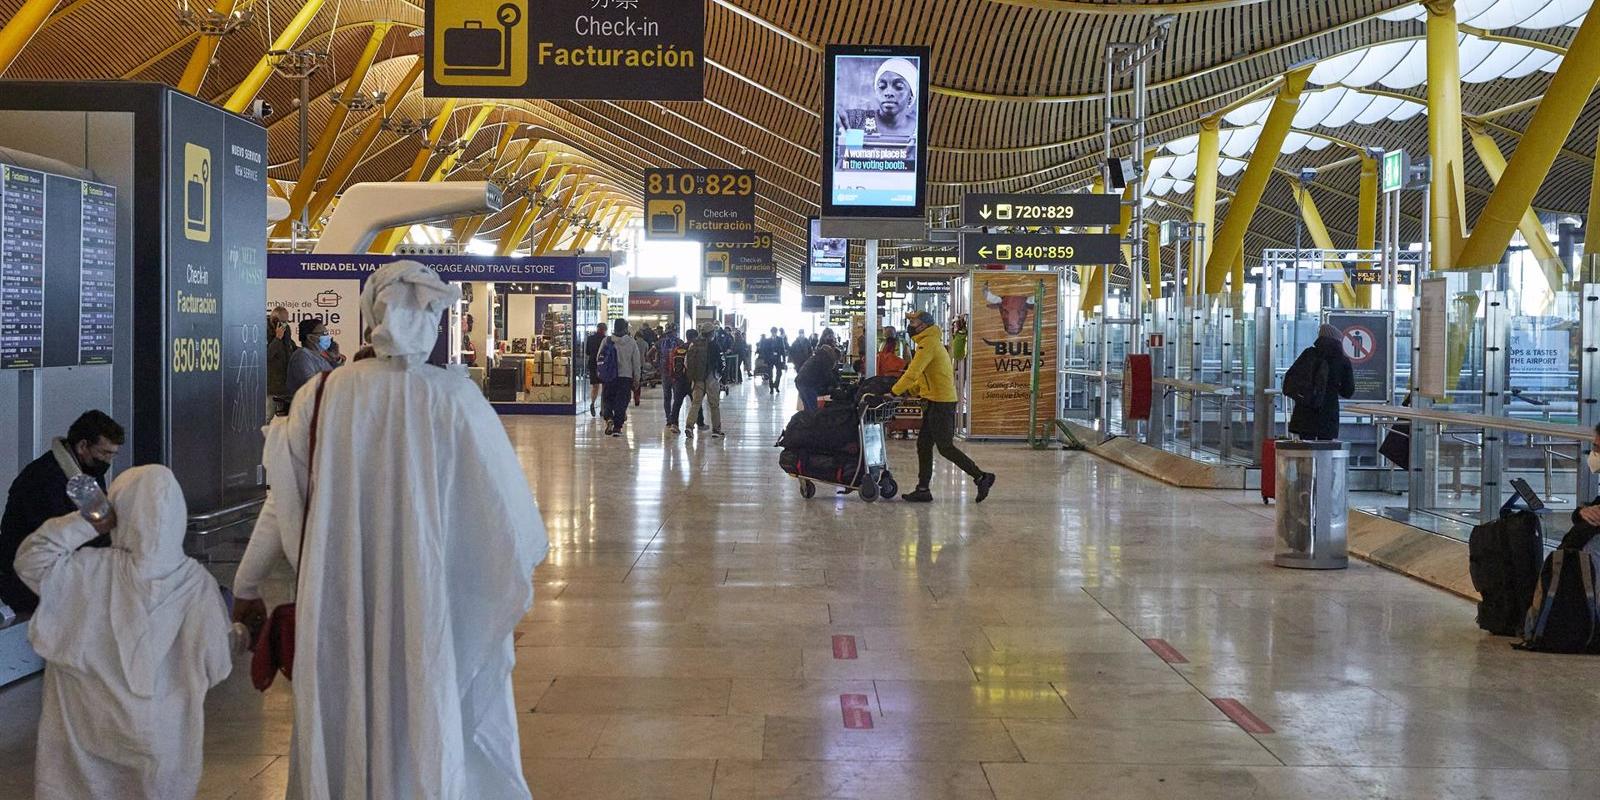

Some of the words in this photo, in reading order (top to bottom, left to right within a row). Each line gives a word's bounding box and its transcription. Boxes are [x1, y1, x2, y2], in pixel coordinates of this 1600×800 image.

[575, 15, 659, 36] Check-in
[538, 42, 694, 67] Facturación
[844, 149, 849, 158] A
[850, 149, 880, 158] woman's
[881, 149, 899, 159] place
[900, 149, 907, 158] is
[842, 160, 849, 169] in
[850, 160, 862, 169] the
[863, 160, 884, 170] voting
[885, 160, 908, 169] booth.
[648, 173, 694, 195] 810
[696, 175, 705, 183] to
[706, 173, 751, 196] 829
[703, 208, 738, 218] Check-in
[1015, 205, 1041, 218] 720
[1047, 205, 1074, 219] 829
[689, 219, 752, 231] Facturación
[1015, 246, 1042, 259] 840
[1048, 246, 1074, 259] 859
[186, 264, 208, 285] Check-in
[300, 262, 337, 271] TIENDA
[338, 263, 358, 272] DEL
[359, 263, 384, 272] VIA
[427, 264, 462, 273] GGAGE
[464, 264, 485, 273] AND
[487, 264, 523, 273] TRAVEL
[524, 264, 555, 274] STORE
[177, 289, 217, 314] Facturación
[267, 300, 299, 308] mbalaje
[301, 300, 312, 308] de
[173, 337, 195, 373] 850
[200, 338, 220, 372] 859
[1511, 357, 1524, 365] THE
[1526, 357, 1557, 365] AIRPORT
